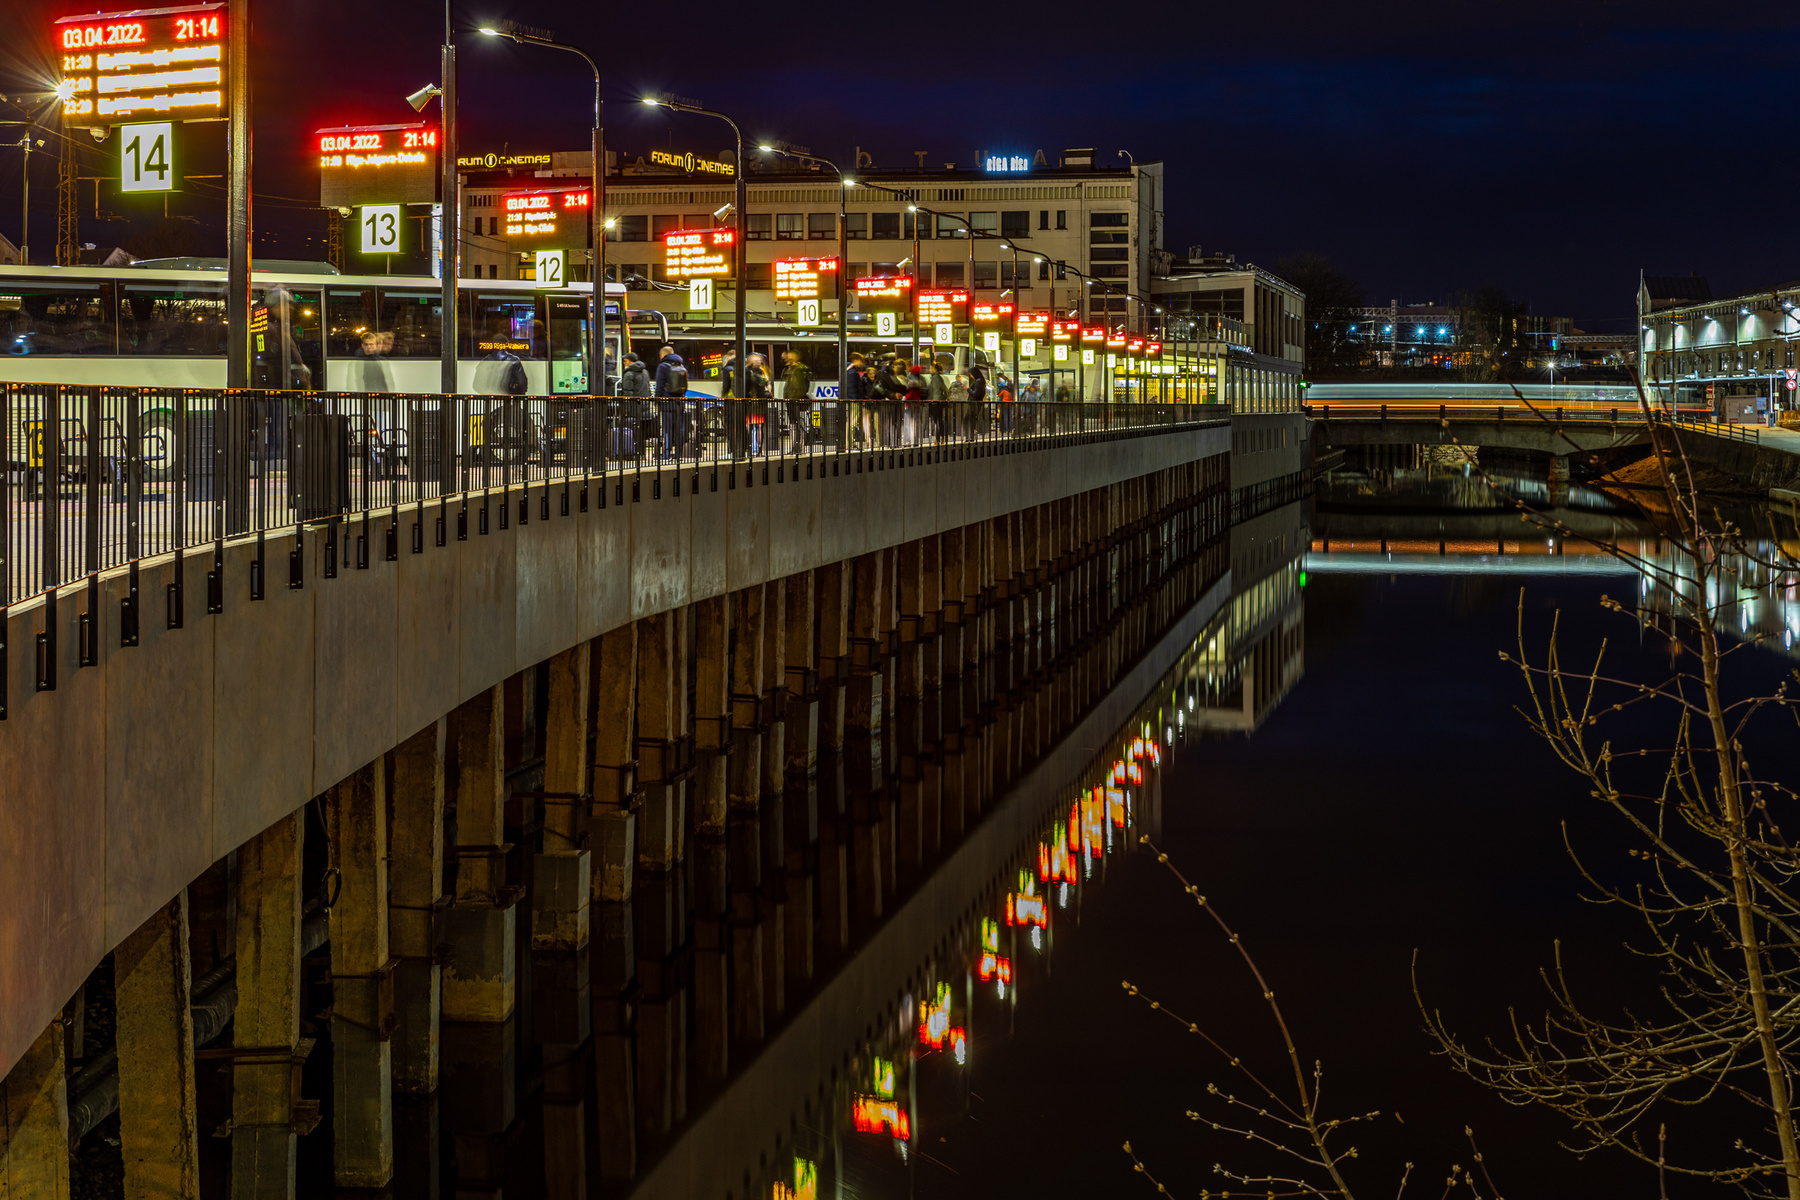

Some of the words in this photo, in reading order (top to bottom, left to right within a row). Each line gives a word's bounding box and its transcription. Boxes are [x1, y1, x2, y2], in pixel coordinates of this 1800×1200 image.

[63, 24, 146, 48] 03.04.2022.
[175, 17, 218, 40] 21:14
[404, 132, 435, 147] 21:14
[125, 134, 169, 182] 14
[651, 150, 684, 168] FORUM
[564, 194, 587, 206] 21:14
[365, 212, 396, 246] 13
[713, 232, 732, 244] 21:14
[539, 256, 560, 282] 12
[693, 283, 708, 305] 11
[801, 304, 817, 322] 10
[882, 316, 891, 333] 9
[940, 327, 948, 341] 8
[988, 335, 995, 348] 7
[1025, 342, 1032, 354] 6
